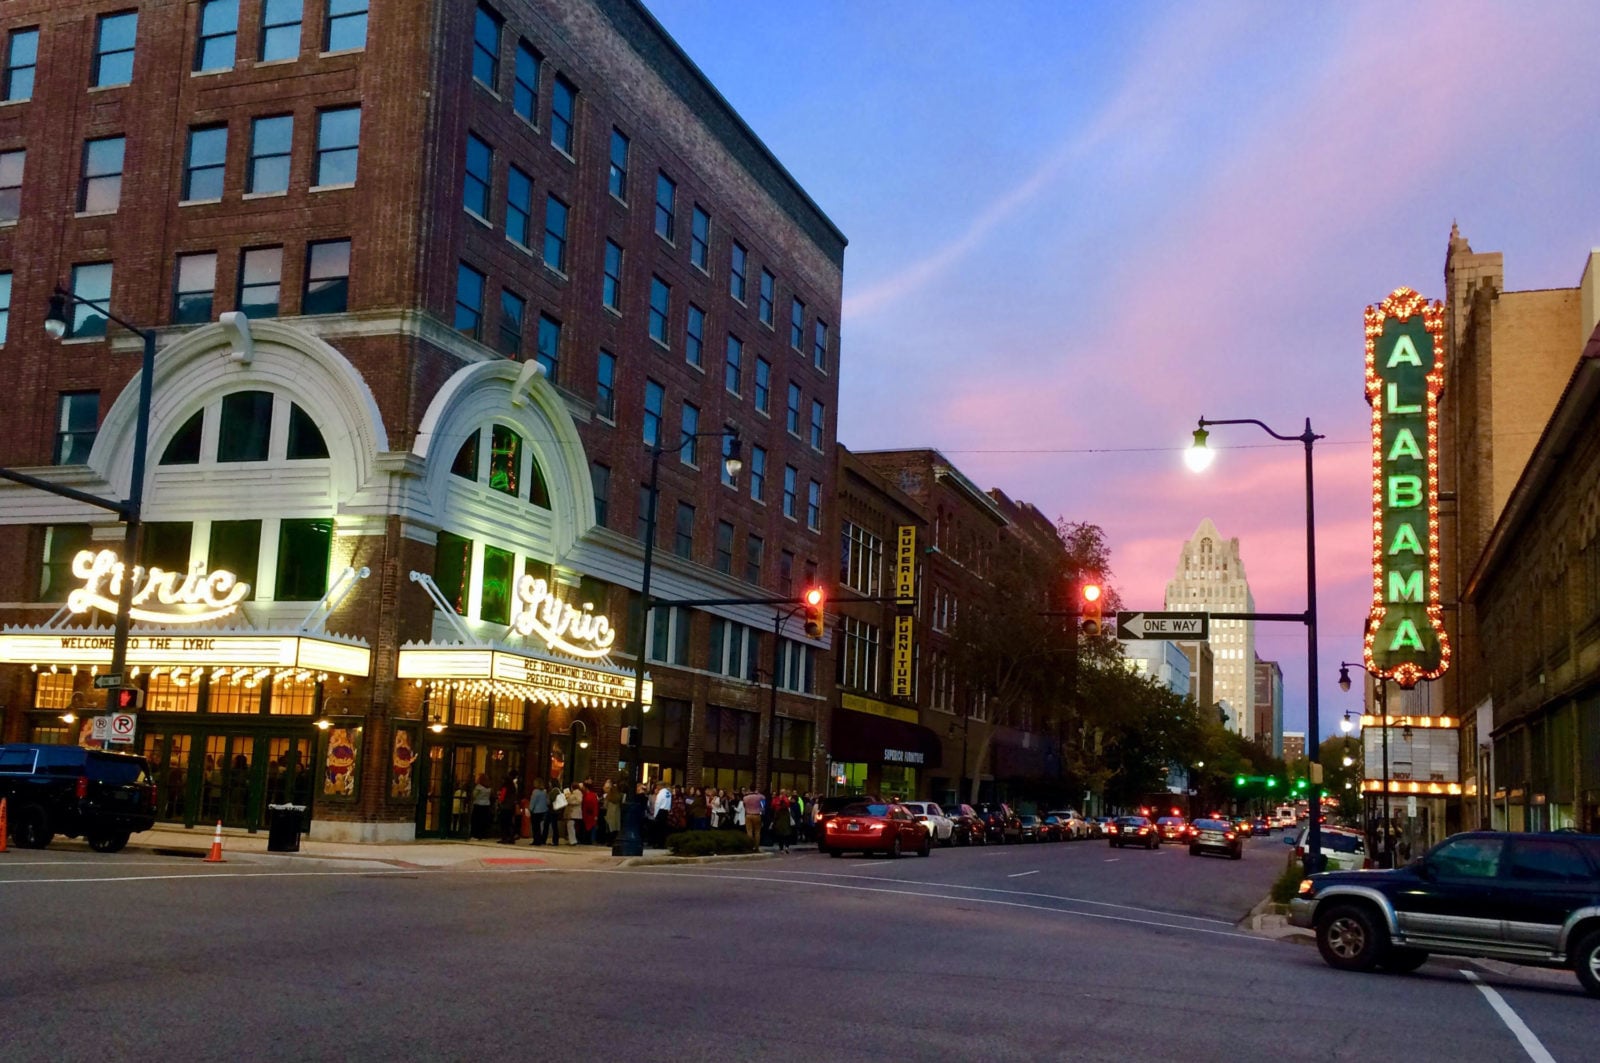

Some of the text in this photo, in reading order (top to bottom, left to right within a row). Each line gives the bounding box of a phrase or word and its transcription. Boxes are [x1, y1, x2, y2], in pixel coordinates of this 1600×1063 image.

[1387, 334, 1424, 651] ALABAMA
[68, 549, 250, 623] Lyric
[900, 528, 912, 598] SUPERIOR
[61, 637, 215, 650] WELCOME O THE LYRIC
[516, 574, 615, 657] Lyric
[1144, 620, 1197, 631] ONE WAY
[526, 672, 565, 688] PRESENTED
[568, 680, 576, 690] BY
[579, 682, 599, 694] BOOKS
[541, 662, 579, 678] DRUMMOND
[582, 670, 598, 682] BOOK
[897, 616, 909, 695] FURNITURE
